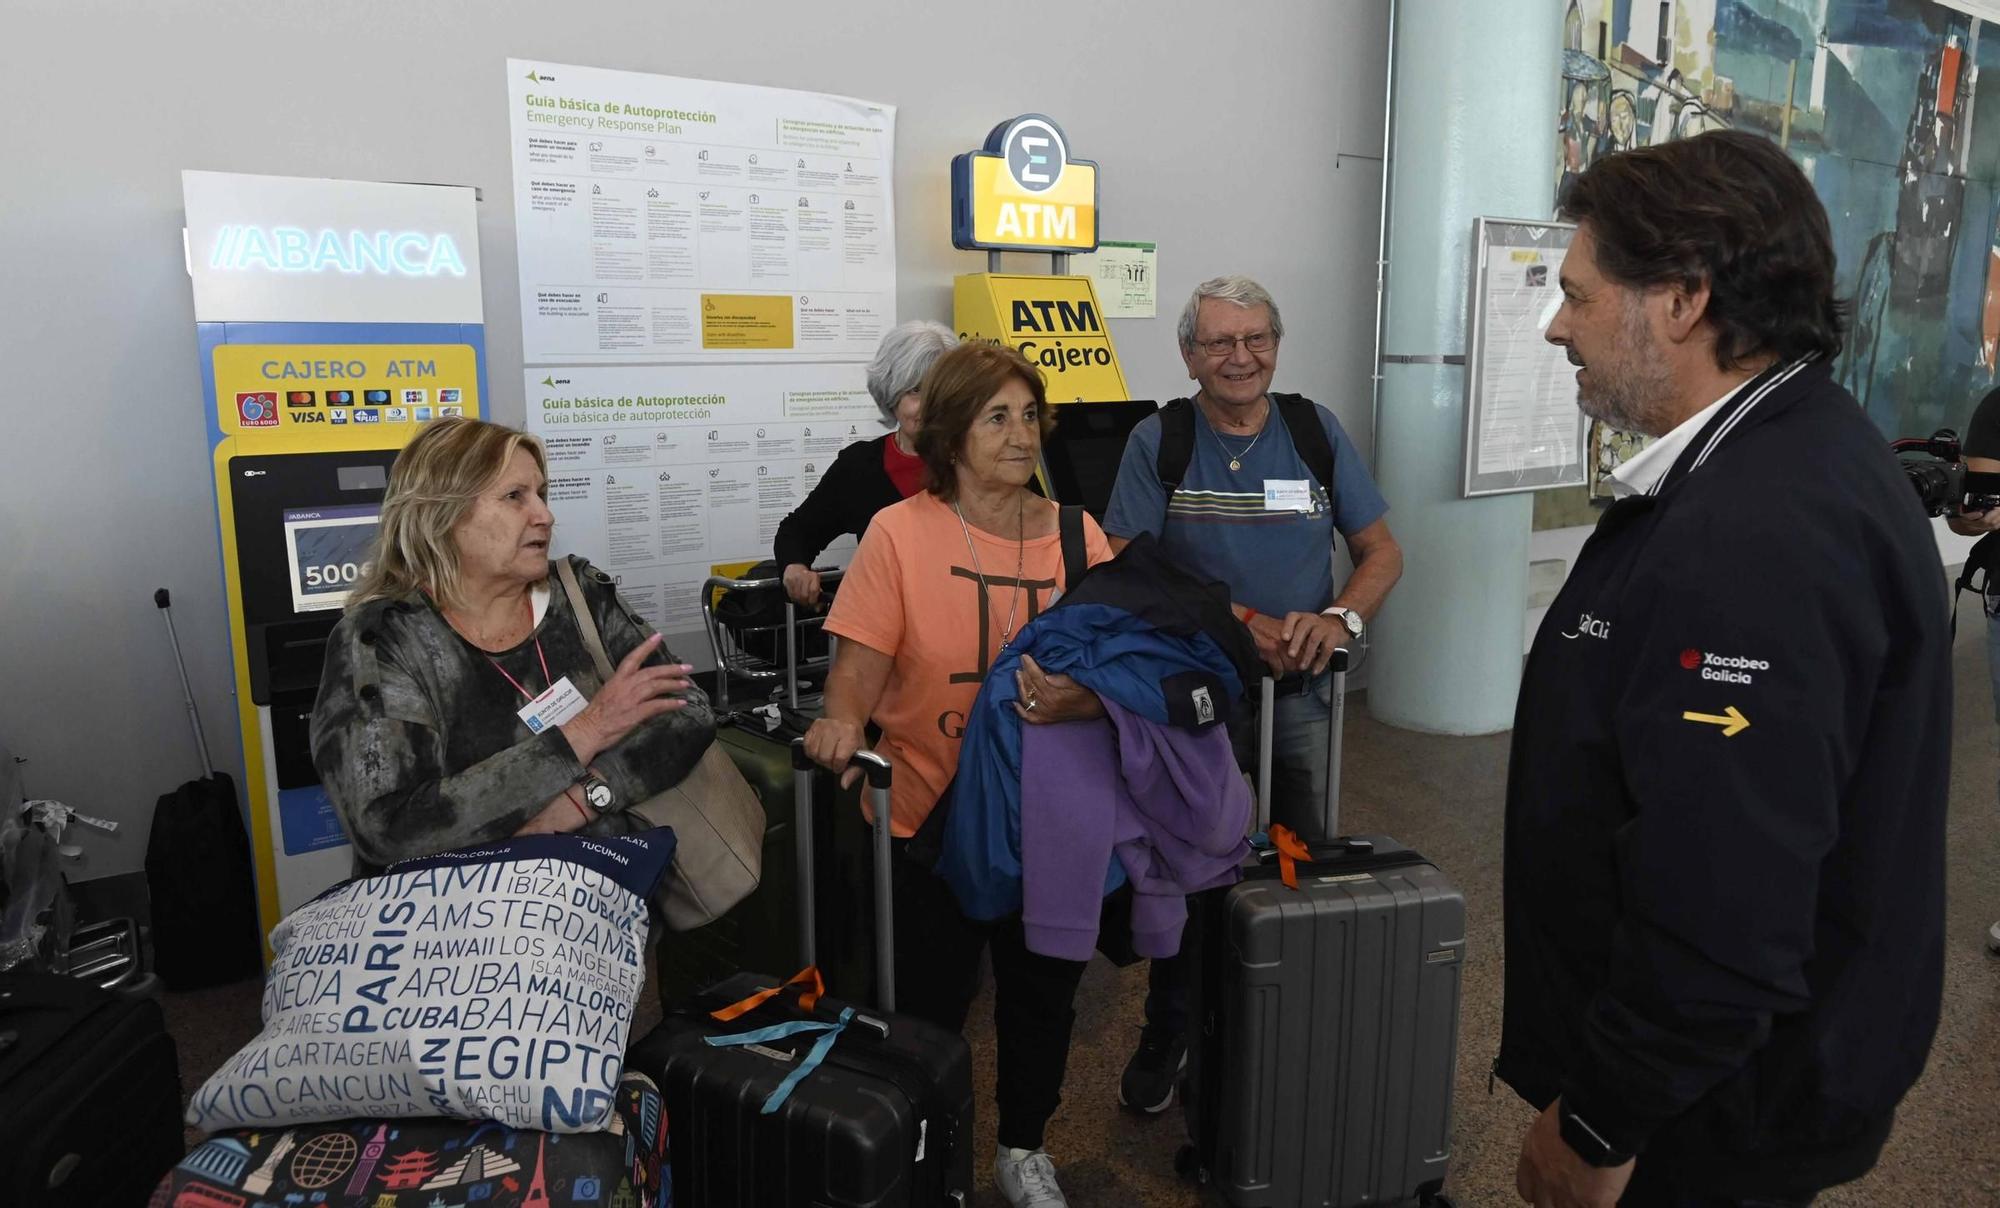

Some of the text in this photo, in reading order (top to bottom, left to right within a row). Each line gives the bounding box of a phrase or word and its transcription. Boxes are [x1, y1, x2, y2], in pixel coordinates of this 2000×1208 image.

[526, 94, 716, 124] Guía básica de Autoprotección
[527, 110, 682, 135] Emergency Response Plan
[995, 201, 1077, 241] ATM
[1012, 299, 1100, 333] ATM
[261, 359, 437, 380] CAJERO ATM
[1019, 341, 1112, 373] Cajero
[542, 393, 726, 410] Guía básica de Autoprotección
[241, 419, 259, 427] EURO
[289, 411, 326, 424] VISA
[361, 413, 378, 423] PLUS
[543, 408, 711, 424] Guía básica de autoprotección
[1703, 652, 1770, 671] Xacobeo
[1702, 667, 1752, 685] Galicia
[581, 840, 629, 866] TUCUMAN
[507, 875, 567, 903] IBIZA
[314, 901, 373, 922] MACHU
[300, 919, 367, 946] PICCHU
[416, 898, 625, 962] AMSTERDAM
[291, 942, 359, 969] DUBAI
[413, 936, 494, 960] HAWAII
[499, 935, 638, 986] LOS ANGELES
[342, 900, 416, 1033] PARIS
[398, 961, 521, 999] ARUBA
[530, 959, 632, 1004] ISLA MARGARITA
[286, 1011, 342, 1035] AIRES
[382, 1005, 458, 1031] CUBA
[460, 996, 621, 1052] BAHAMA
[274, 1038, 413, 1068] CARTAGENA
[454, 1035, 624, 1092] EGIPTO
[276, 1073, 412, 1104] CANCUN
[457, 1084, 531, 1104] MACHU
